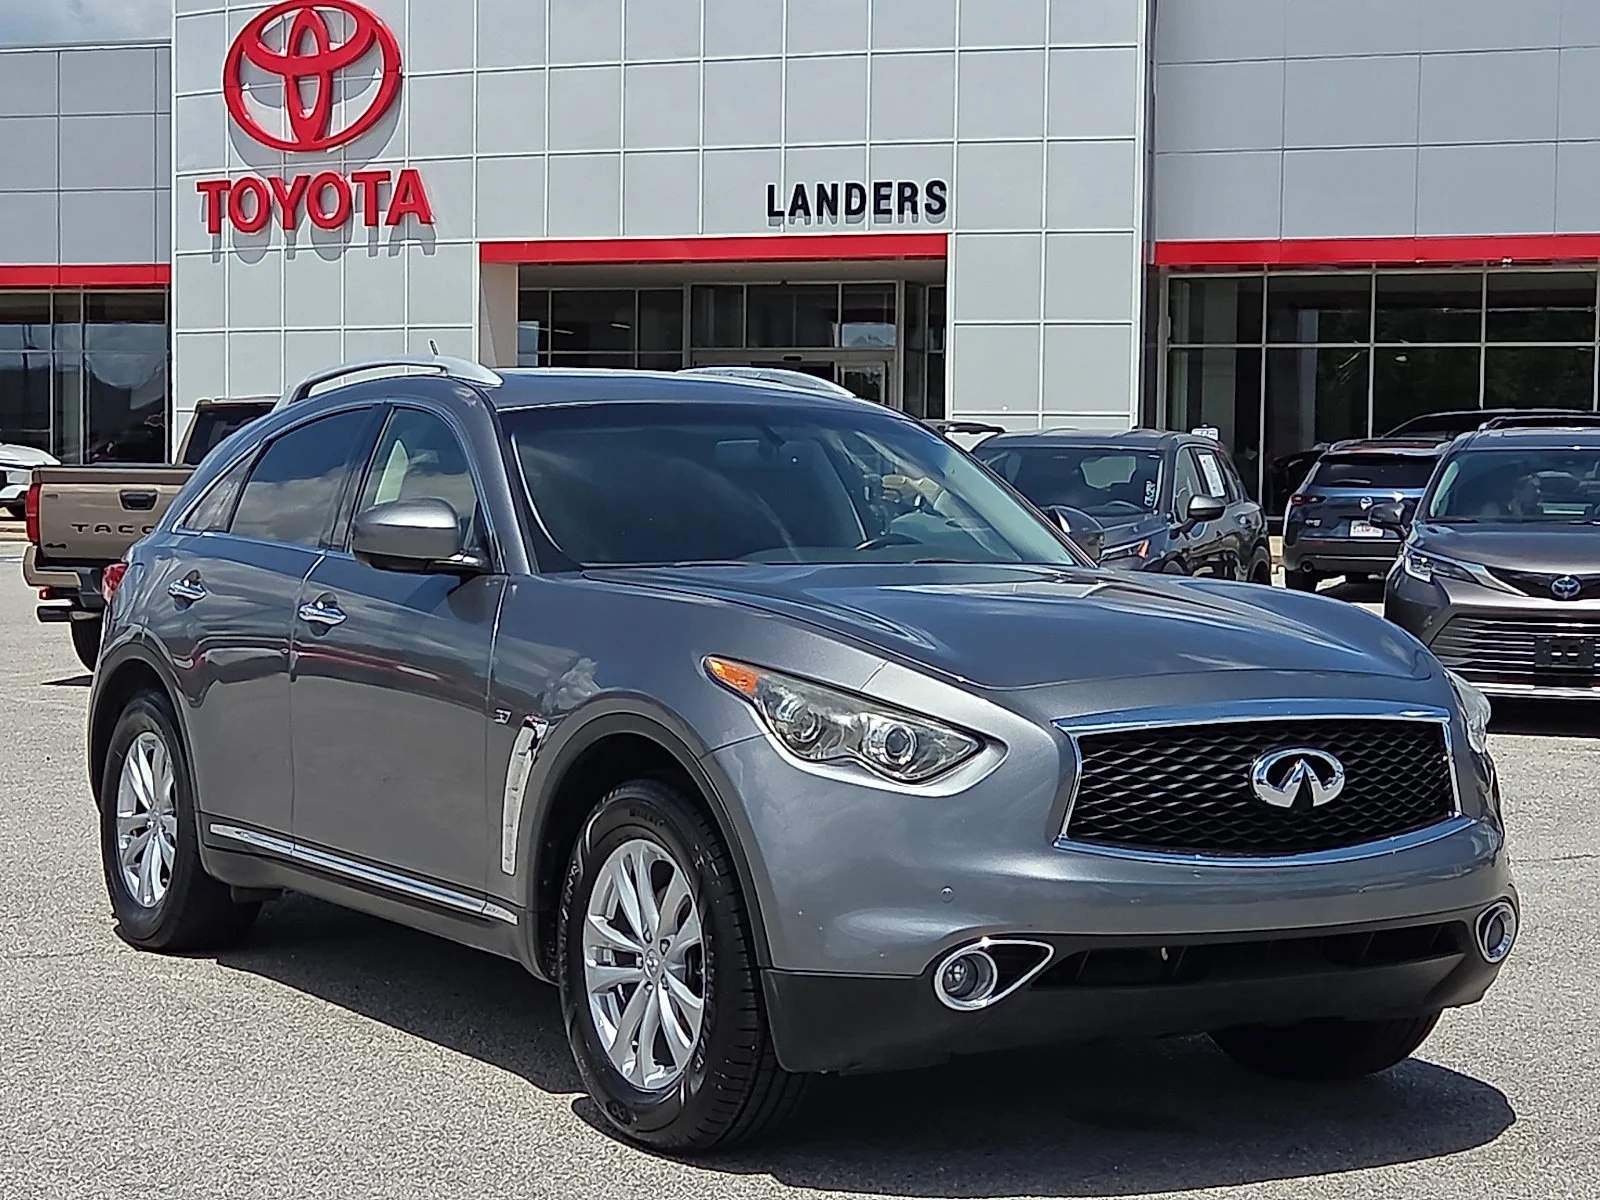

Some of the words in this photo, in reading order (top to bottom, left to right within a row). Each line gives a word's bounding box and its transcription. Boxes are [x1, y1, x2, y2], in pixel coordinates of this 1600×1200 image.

[196, 169, 433, 234] TOYOTA
[767, 180, 947, 217] LANDERS
[71, 523, 155, 535] TACO
